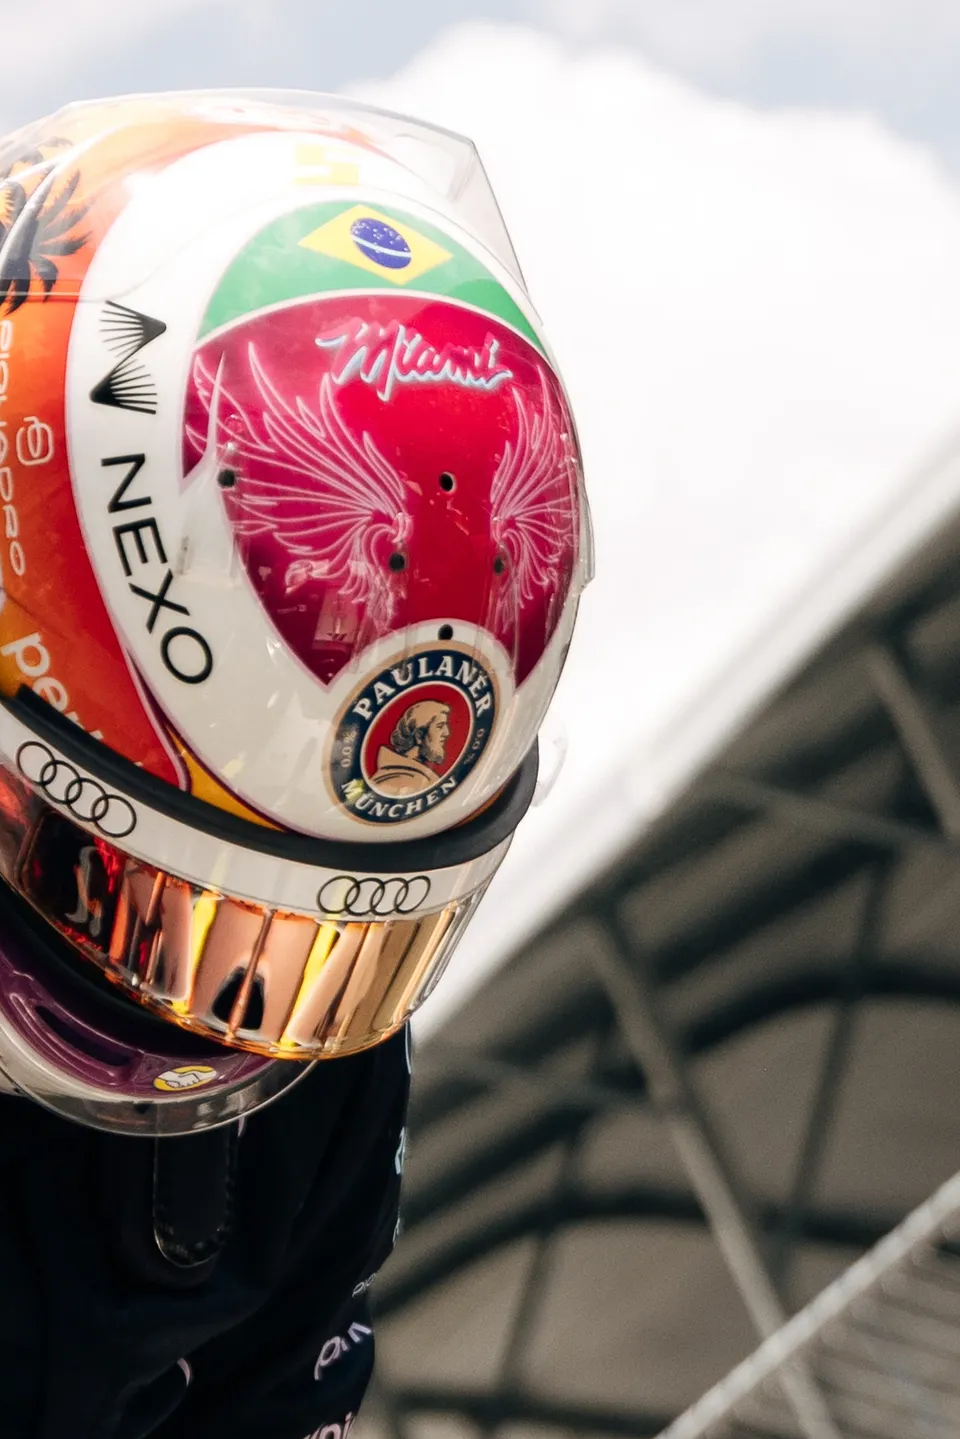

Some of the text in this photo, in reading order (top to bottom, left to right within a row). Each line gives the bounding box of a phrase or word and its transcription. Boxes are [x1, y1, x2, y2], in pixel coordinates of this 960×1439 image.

[101, 453, 214, 685] NEXO
[353, 655, 491, 721] PAULANER
[341, 776, 458, 818] MÜNCHEN
